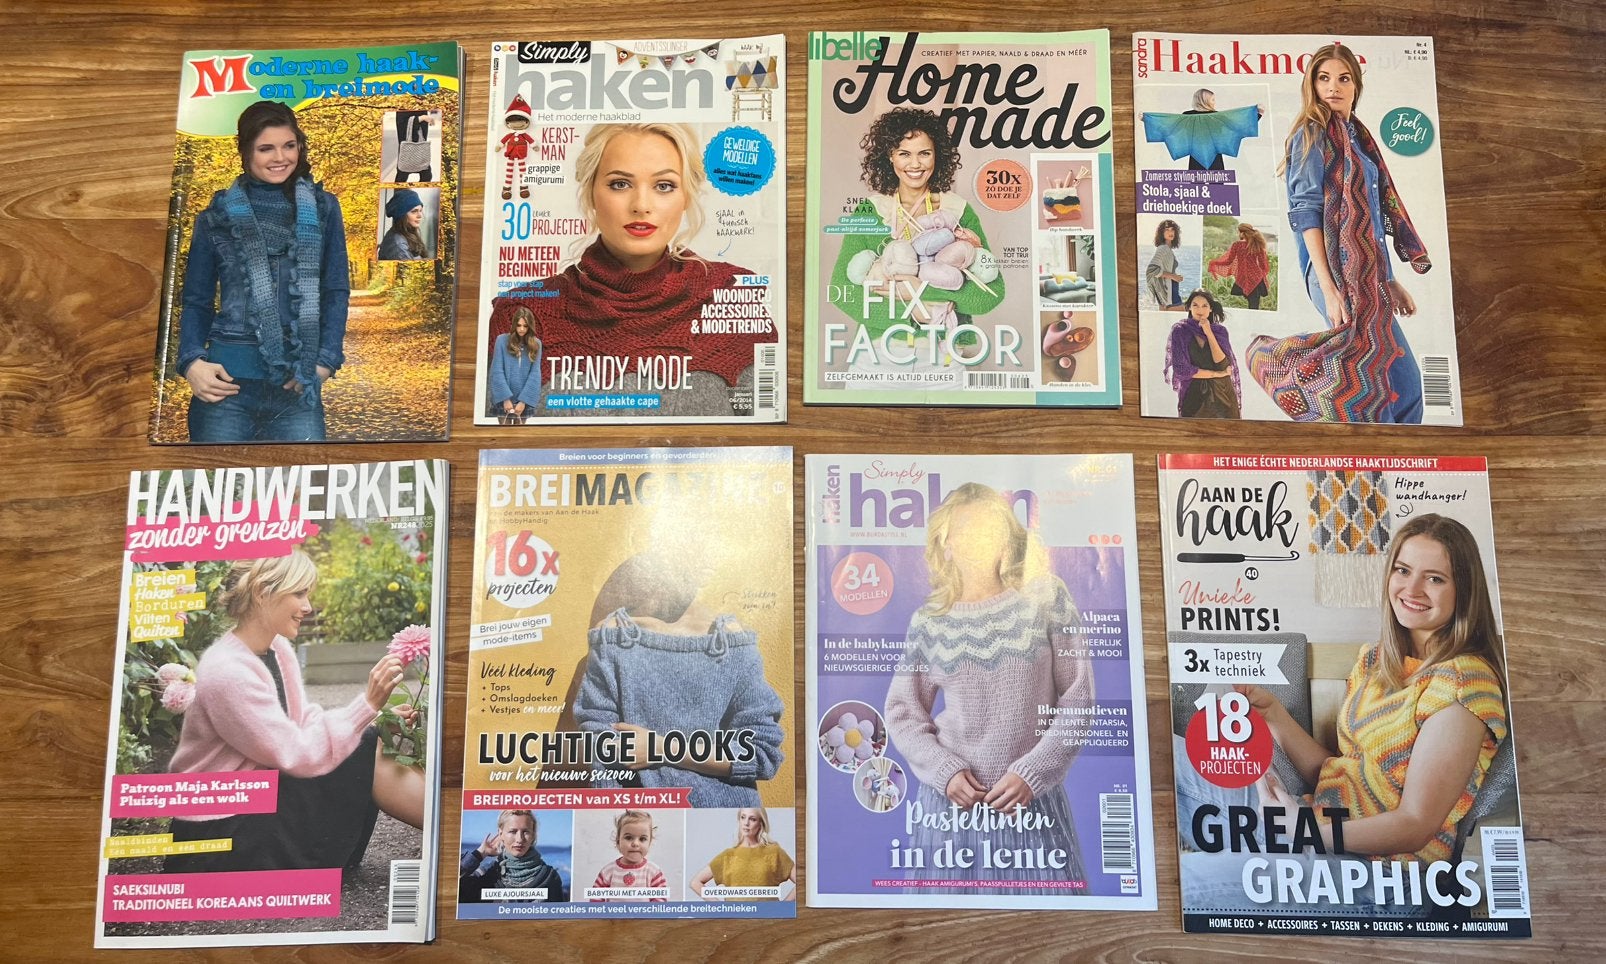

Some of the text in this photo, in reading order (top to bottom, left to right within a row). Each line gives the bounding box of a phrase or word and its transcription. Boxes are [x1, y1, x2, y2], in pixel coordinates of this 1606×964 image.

[520, 41, 589, 65] Simply
[808, 31, 882, 62] libelle
[972, 50, 997, 58] PAPIER,
[1057, 49, 1066, 57] EN
[1068, 48, 1088, 57] MÉÉR
[1137, 38, 1148, 78] sandra
[189, 50, 439, 98] Moderne haak-
[833, 31, 1045, 115] Home
[259, 75, 440, 100] en breimode
[503, 53, 714, 111] haken
[538, 112, 641, 121] Het moderne haakblad
[939, 83, 1112, 149] made
[1390, 112, 1422, 131] Feel
[541, 127, 580, 144] KERST-
[1388, 127, 1428, 148] good!
[723, 136, 761, 153] GEWELDIGE
[541, 145, 566, 161] MAN
[722, 149, 758, 165] MODELLEN
[528, 164, 561, 174] grappige
[523, 175, 565, 185] amigurumi
[986, 170, 1022, 185] 30x
[1142, 183, 1211, 200] Stola, sjaal &
[1142, 199, 1233, 216] driehoekige doek
[501, 201, 531, 240] 30
[532, 219, 587, 235] PROJECTEN
[499, 246, 560, 261] NU METEEN
[498, 262, 557, 277] BEGINNEN!
[742, 276, 770, 285] PLUS
[712, 288, 772, 304] WOONDECO
[825, 284, 855, 303] DE
[862, 279, 932, 320] FIX
[700, 303, 772, 319] ACCESSOIRES
[690, 319, 772, 334] & MODETRENDS
[824, 323, 1022, 366] FACTOR
[546, 355, 629, 391] TRENDY
[636, 354, 693, 391] MODE
[826, 373, 954, 382] ZELFGEMAAKT IS ALTIJD LEUKER
[548, 396, 659, 408] een vlotte gehaakte cape
[1213, 454, 1438, 469] HET ENIGE ÉCHTE NEDERLANDSE HAAKTIJDSCHRIFT
[863, 459, 926, 484] Simply
[1394, 476, 1425, 490] Hippe
[127, 459, 442, 525] HANDWERKEN
[1200, 487, 1263, 503] AAN DE
[1395, 489, 1467, 503] wandhanger!
[1176, 478, 1300, 548] haak
[128, 517, 307, 550] zonder grenzen
[486, 529, 560, 577] 16x
[135, 571, 186, 587] Breien
[843, 562, 881, 590] 34
[1245, 568, 1258, 579] 40
[134, 586, 176, 600] Haken
[486, 577, 557, 600] projecten
[839, 589, 889, 603] MODELLEN
[1178, 577, 1257, 606] Unieke
[135, 599, 204, 613] Borduren
[134, 613, 171, 625] Vilten
[1081, 610, 1120, 624] Alpaca
[1181, 607, 1280, 632] PRINTS!
[133, 624, 180, 639] Quilten
[480, 617, 547, 634] Brei jouw eigen
[1062, 624, 1122, 635] en merino
[483, 631, 537, 645] mode-items
[823, 638, 919, 652] In de babykamer
[823, 653, 906, 661] 6 MODELLEN VOOR
[1184, 649, 1211, 673] 3x
[1213, 648, 1262, 664] Tapestry
[508, 662, 557, 687] kleding
[823, 664, 930, 673] NIEUWSGIERIGE OOGJES
[1214, 664, 1266, 678] techniek
[490, 682, 511, 692] Tops
[490, 693, 558, 704] Omslagdoeken
[490, 705, 520, 715] Vestjes
[1037, 704, 1128, 716] Bloemmotieven
[1193, 691, 1253, 744] 18
[478, 731, 636, 766] LUCHTIGE
[647, 729, 757, 763] LOOKS
[1210, 746, 1250, 761] HAAK-
[1199, 760, 1261, 775] PROJECTEN
[120, 778, 270, 794] Patroon Maja Karlsson
[119, 792, 250, 808] Pluizig als een wolk
[473, 793, 681, 806] BREIPROJECTEN van XS t/m XL!
[904, 800, 1056, 834] Pasteltinten
[1191, 804, 1350, 855] GREAT
[890, 838, 1067, 869] in de lente
[113, 883, 185, 896] SAEKSILNUBI
[1241, 856, 1483, 908] GRAPHICS
[485, 889, 545, 898] LUXE AJOURSJAAL
[587, 889, 668, 898] BABYTRUI MET AARDBEI
[704, 888, 779, 897] OVERDWARS GEBREID
[112, 893, 331, 911] TRADITIONEEL KOREAANS QUILTWERK
[498, 904, 757, 914] De mooiste creaties met veel verschillende breitechnieken
